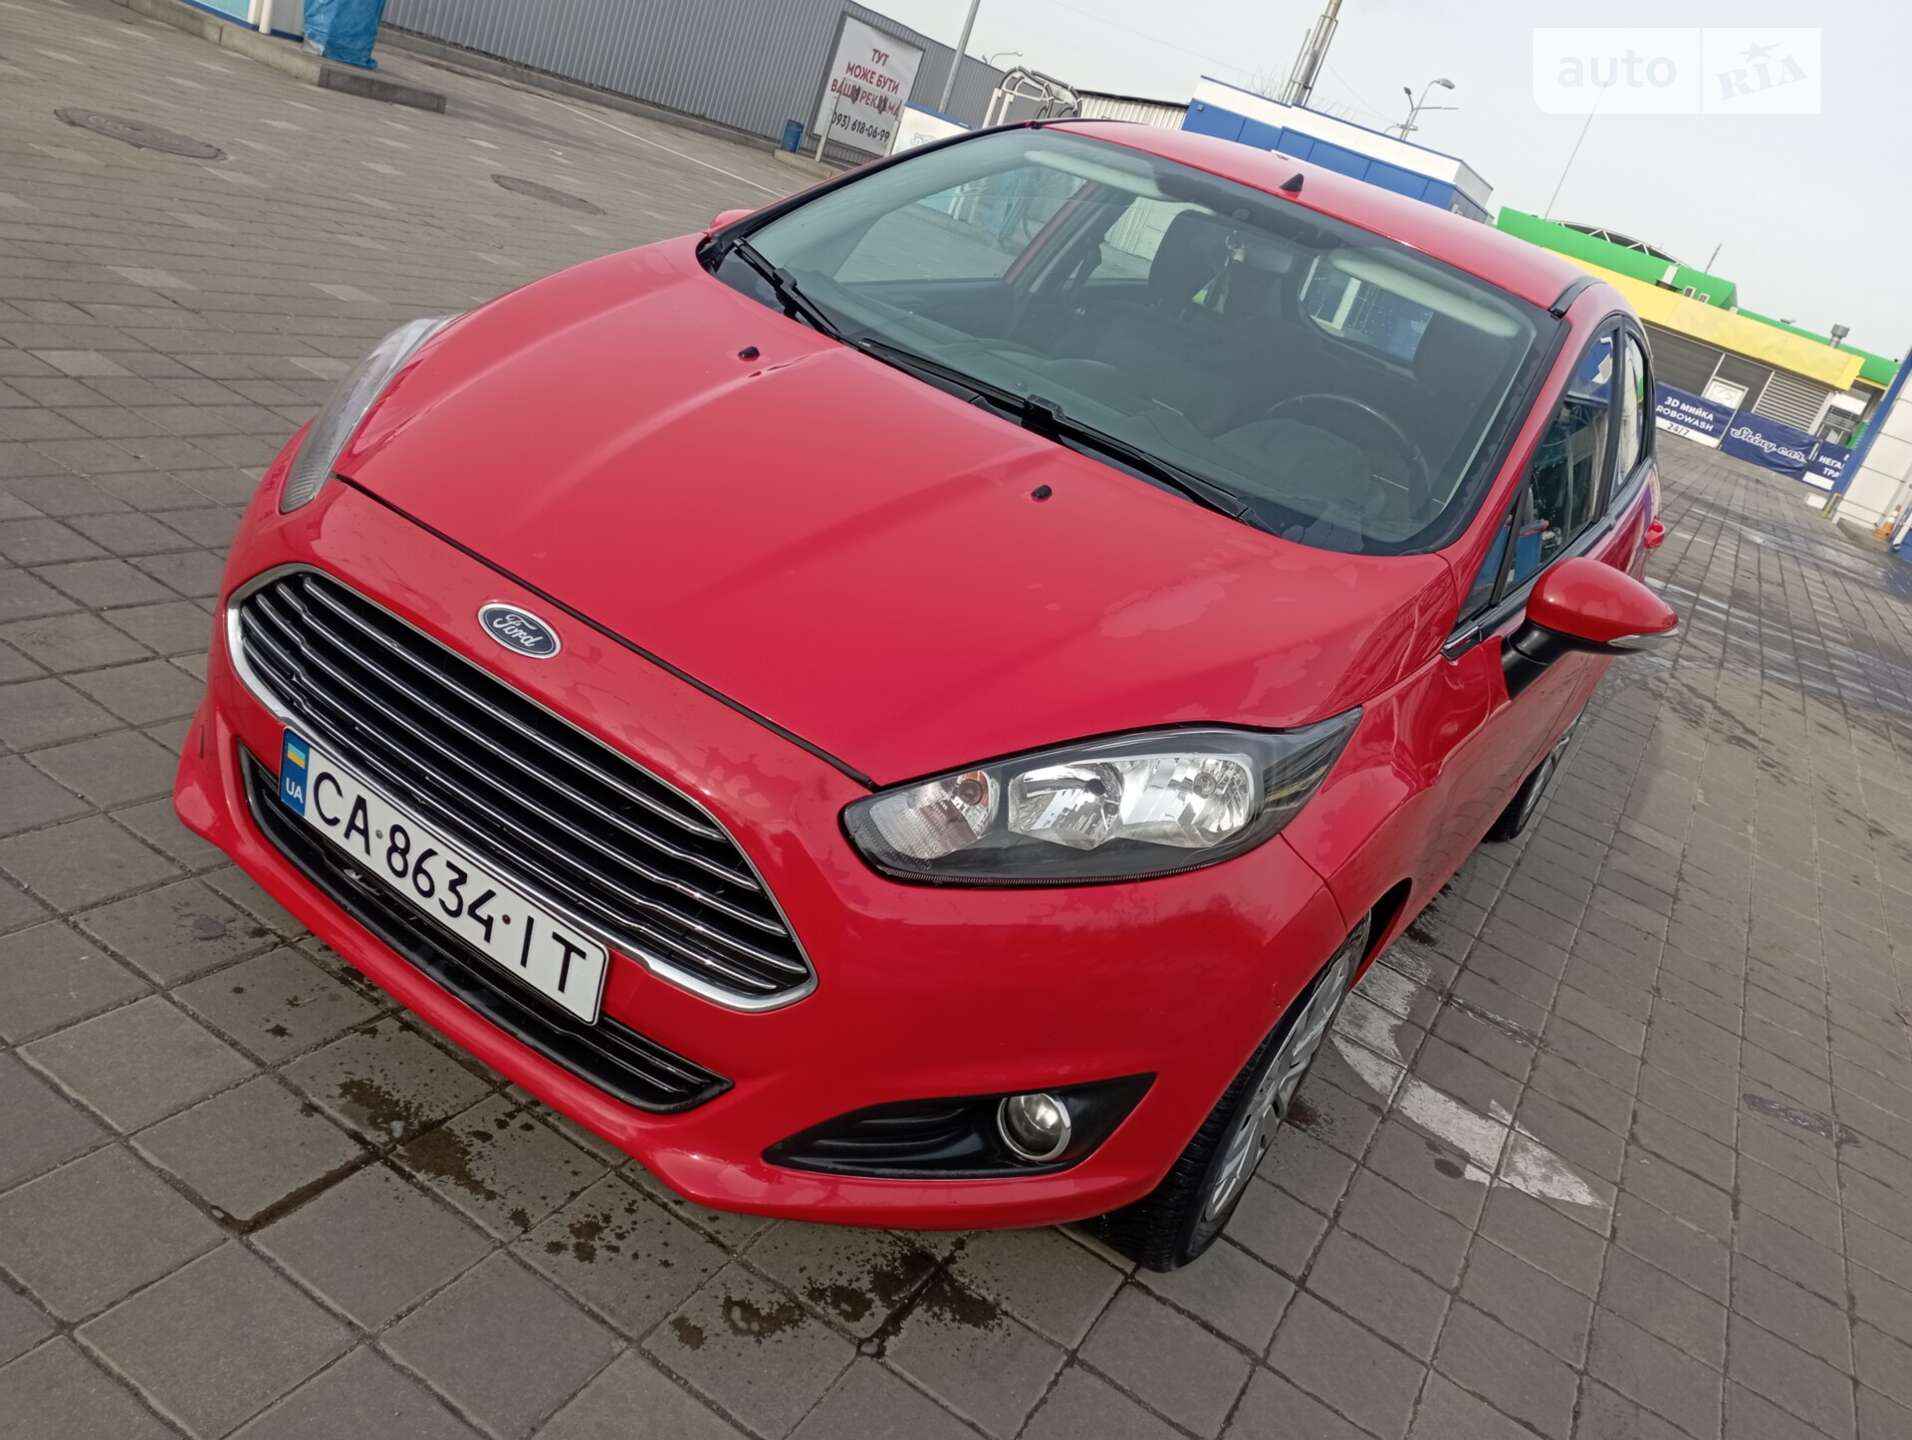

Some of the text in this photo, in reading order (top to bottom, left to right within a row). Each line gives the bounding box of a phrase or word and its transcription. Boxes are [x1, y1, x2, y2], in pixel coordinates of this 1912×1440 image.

[871, 48, 889, 66] ТУТ
[831, 78, 860, 101] ВАШ
[846, 61, 900, 94] МОЖЕ БУТИ
[851, 119, 890, 142] 618-06-99
[1655, 405, 1714, 431] ROBOWASH
[1664, 396, 1713, 421] 3D МИЙКА
[1667, 422, 1690, 435] 24/7
[1730, 427, 1777, 453] Shiny
[493, 614, 543, 647] Ford
[285, 776, 304, 804] UA
[313, 771, 587, 994] CA 8634 IT
